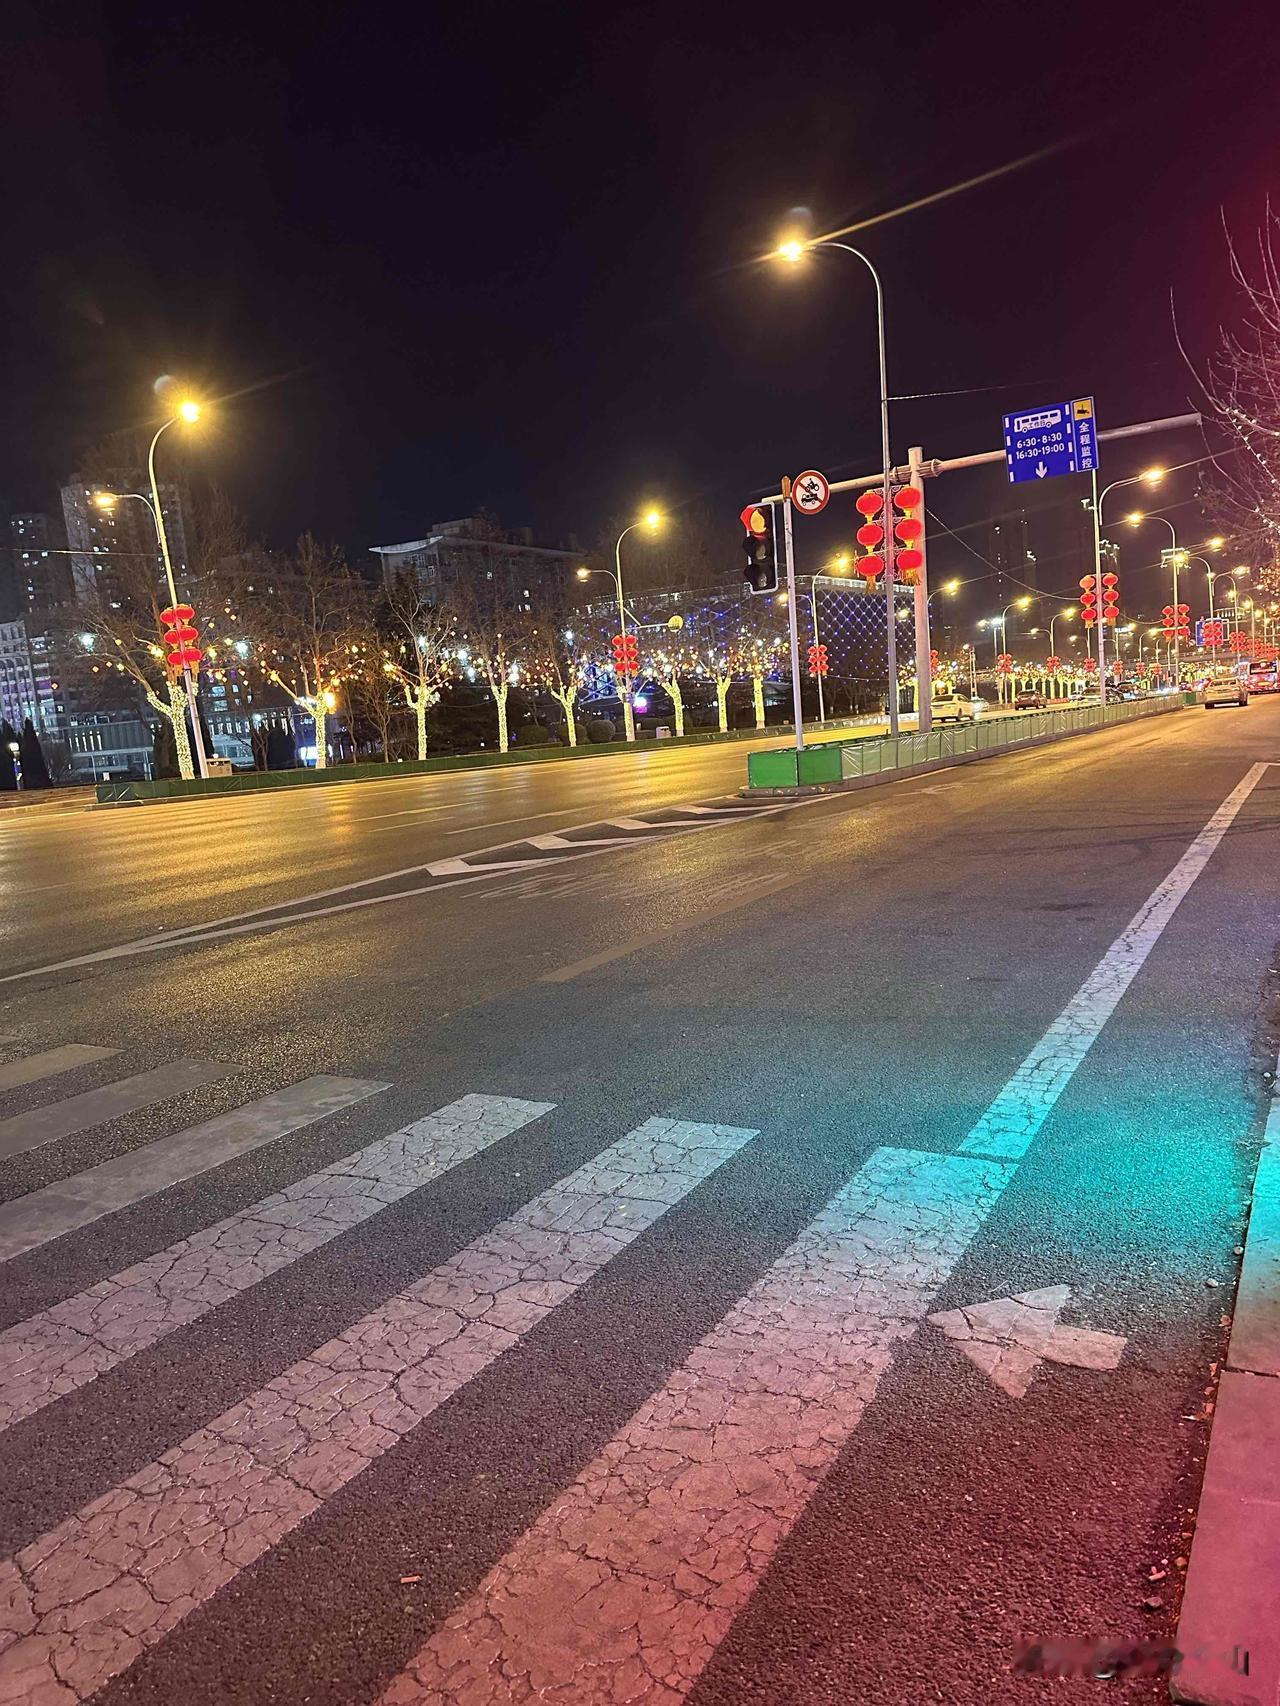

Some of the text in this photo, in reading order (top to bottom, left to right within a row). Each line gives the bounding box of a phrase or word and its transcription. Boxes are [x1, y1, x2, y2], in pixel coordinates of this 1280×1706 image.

[1016, 443, 1065, 459] 16:30-19:00
[1079, 422, 1093, 469] 全程监控
